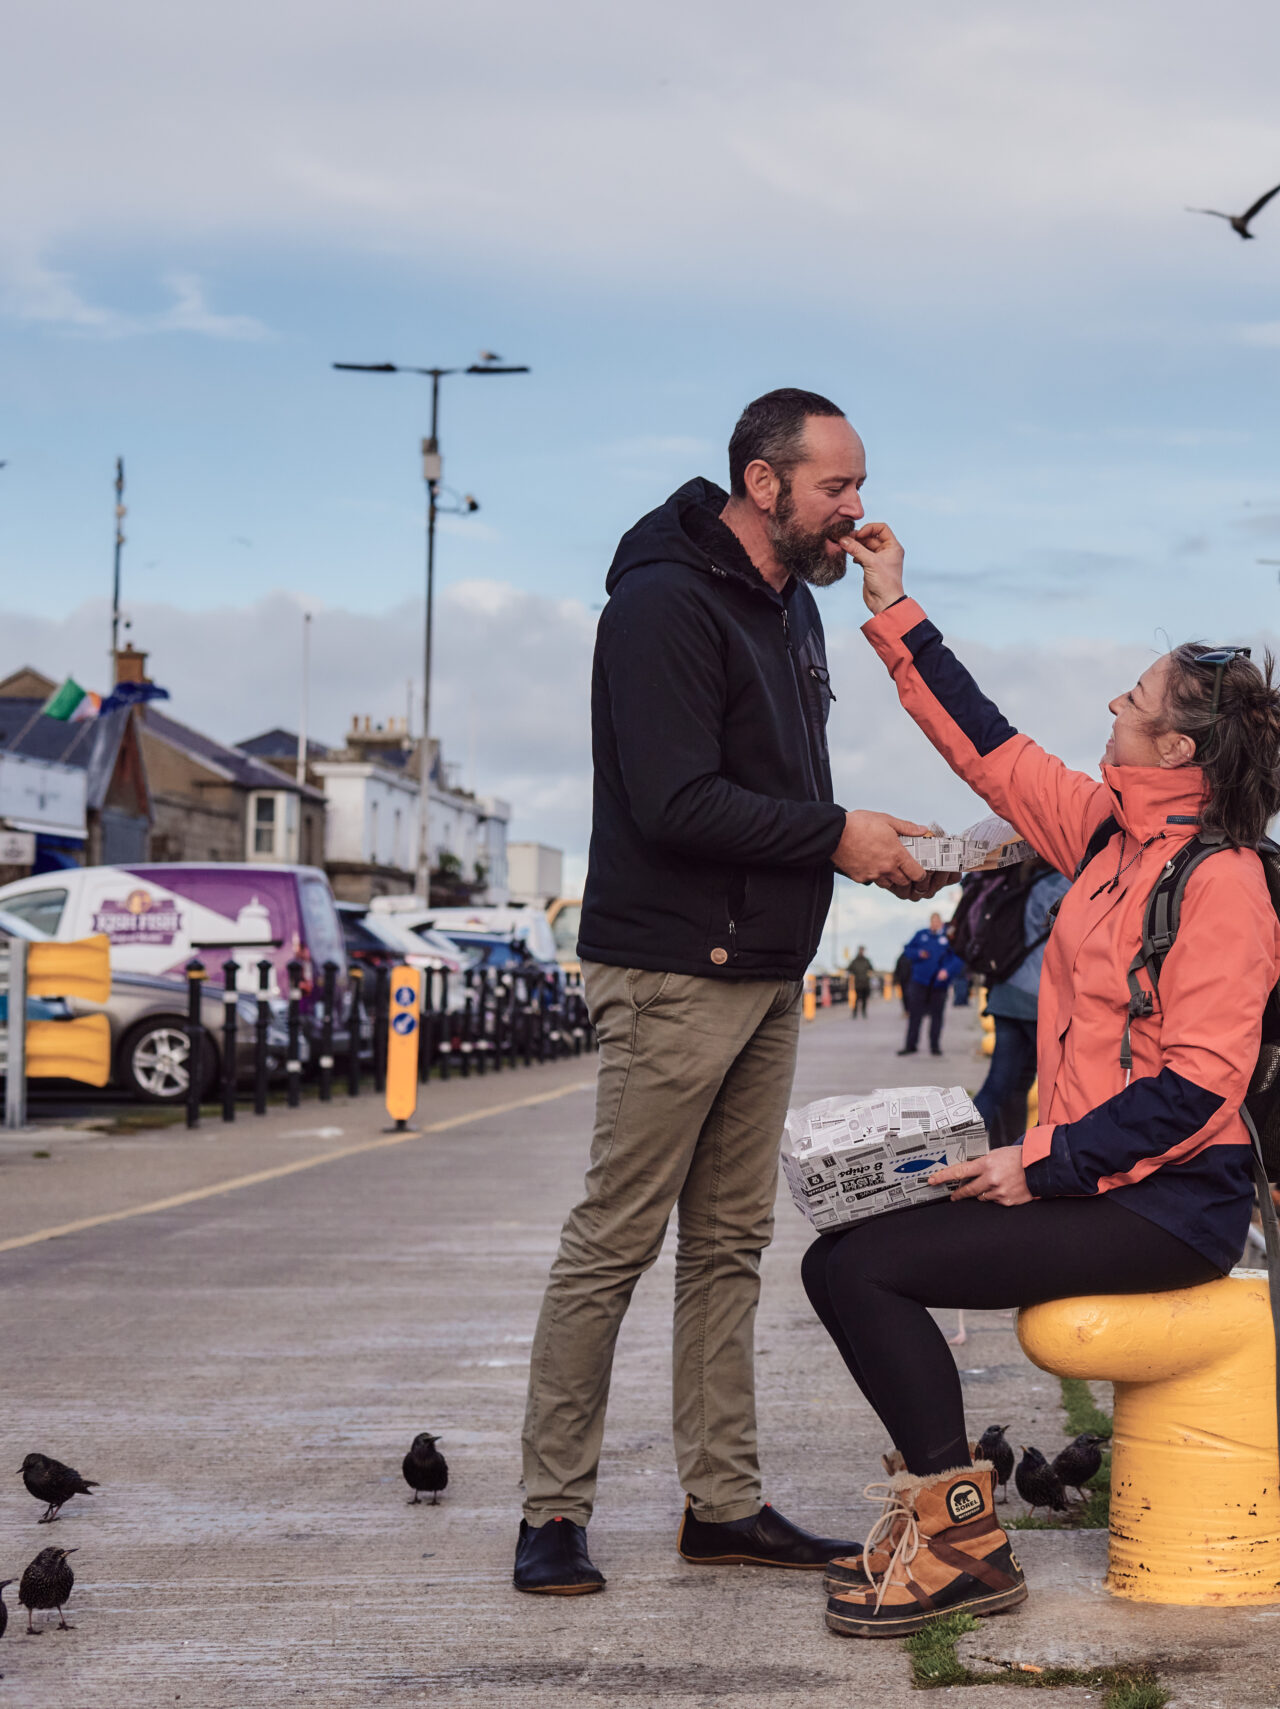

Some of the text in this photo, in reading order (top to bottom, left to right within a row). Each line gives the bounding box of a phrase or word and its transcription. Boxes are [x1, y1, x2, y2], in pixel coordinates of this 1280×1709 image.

[838, 1162, 883, 1178] & chips
[840, 1172, 885, 1192] FISH
[955, 1499, 978, 1513] SOREL
